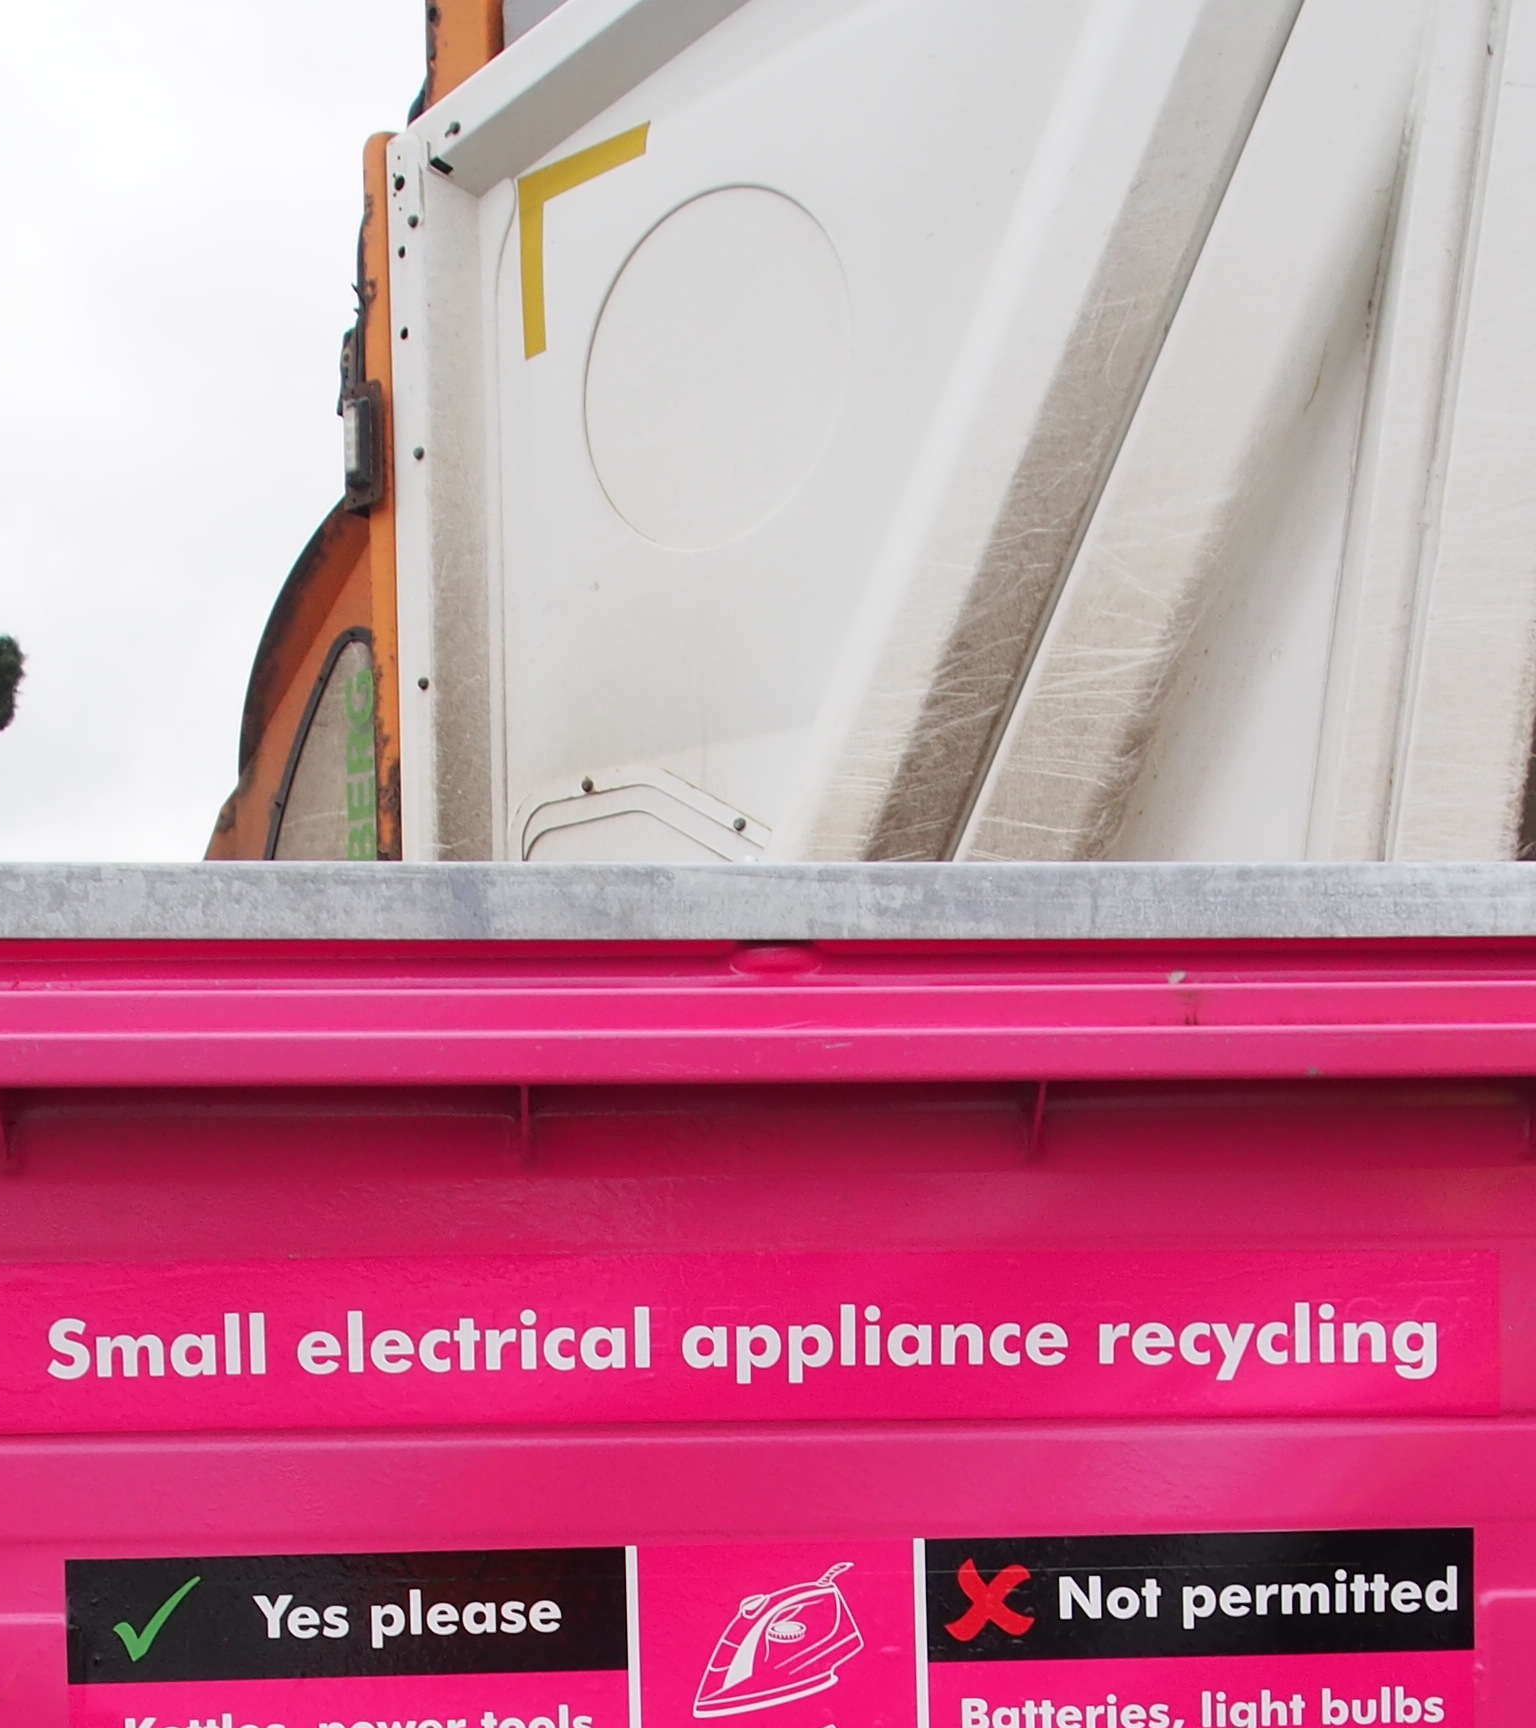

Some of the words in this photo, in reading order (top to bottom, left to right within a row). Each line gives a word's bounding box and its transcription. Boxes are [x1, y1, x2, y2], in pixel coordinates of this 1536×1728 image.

[47, 1312, 266, 1380] Small
[297, 1306, 651, 1375] electrical
[682, 1304, 1069, 1384] appliance
[1099, 1302, 1437, 1381] recycling
[252, 1594, 350, 1639] Yes
[371, 1588, 562, 1649] please
[1058, 1573, 1161, 1620] Not
[1182, 1566, 1458, 1630] permitted
[1321, 1686, 1445, 1725] bulbs
